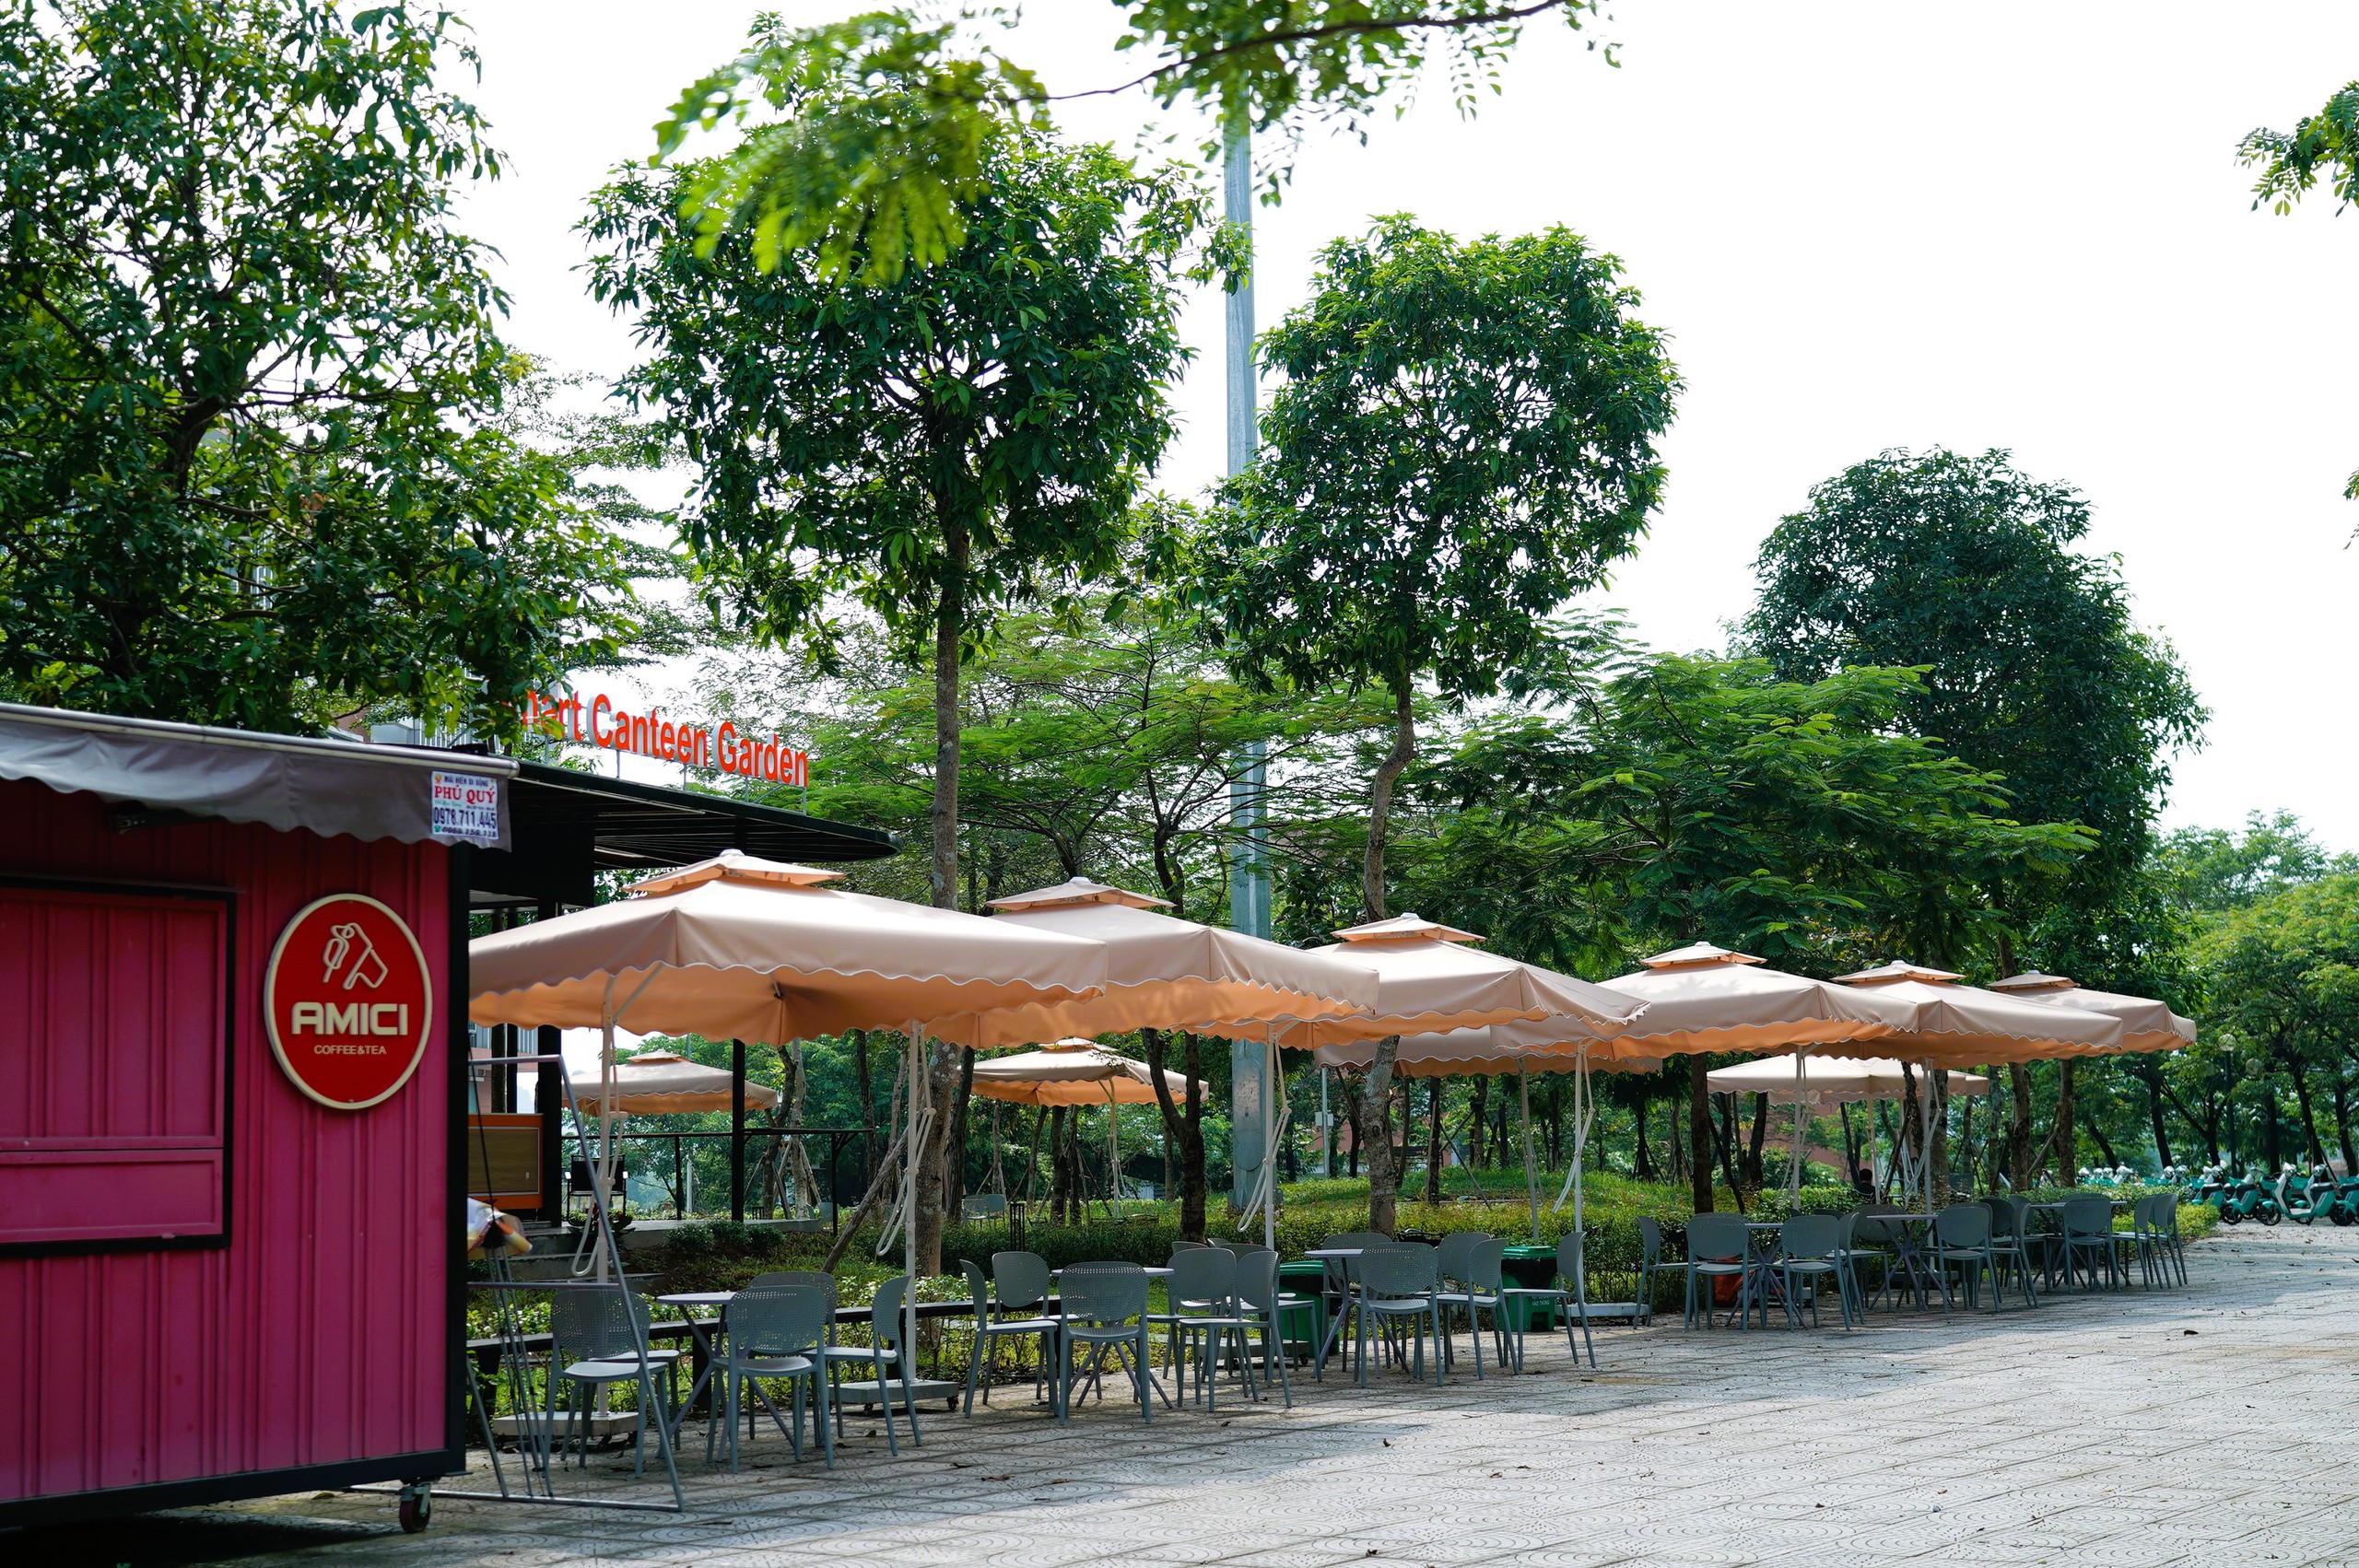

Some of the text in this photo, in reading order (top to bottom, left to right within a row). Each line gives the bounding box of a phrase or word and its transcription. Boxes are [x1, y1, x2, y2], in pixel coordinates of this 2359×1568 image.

[592, 693, 709, 767] Canteen
[716, 720, 809, 787] Garden
[434, 785, 462, 801] PHÚ
[466, 788, 496, 804] QUÝ
[434, 807, 496, 829] 0978.711.445
[291, 1001, 408, 1036] AMICI
[313, 1045, 387, 1055] COFFEE&TEA
